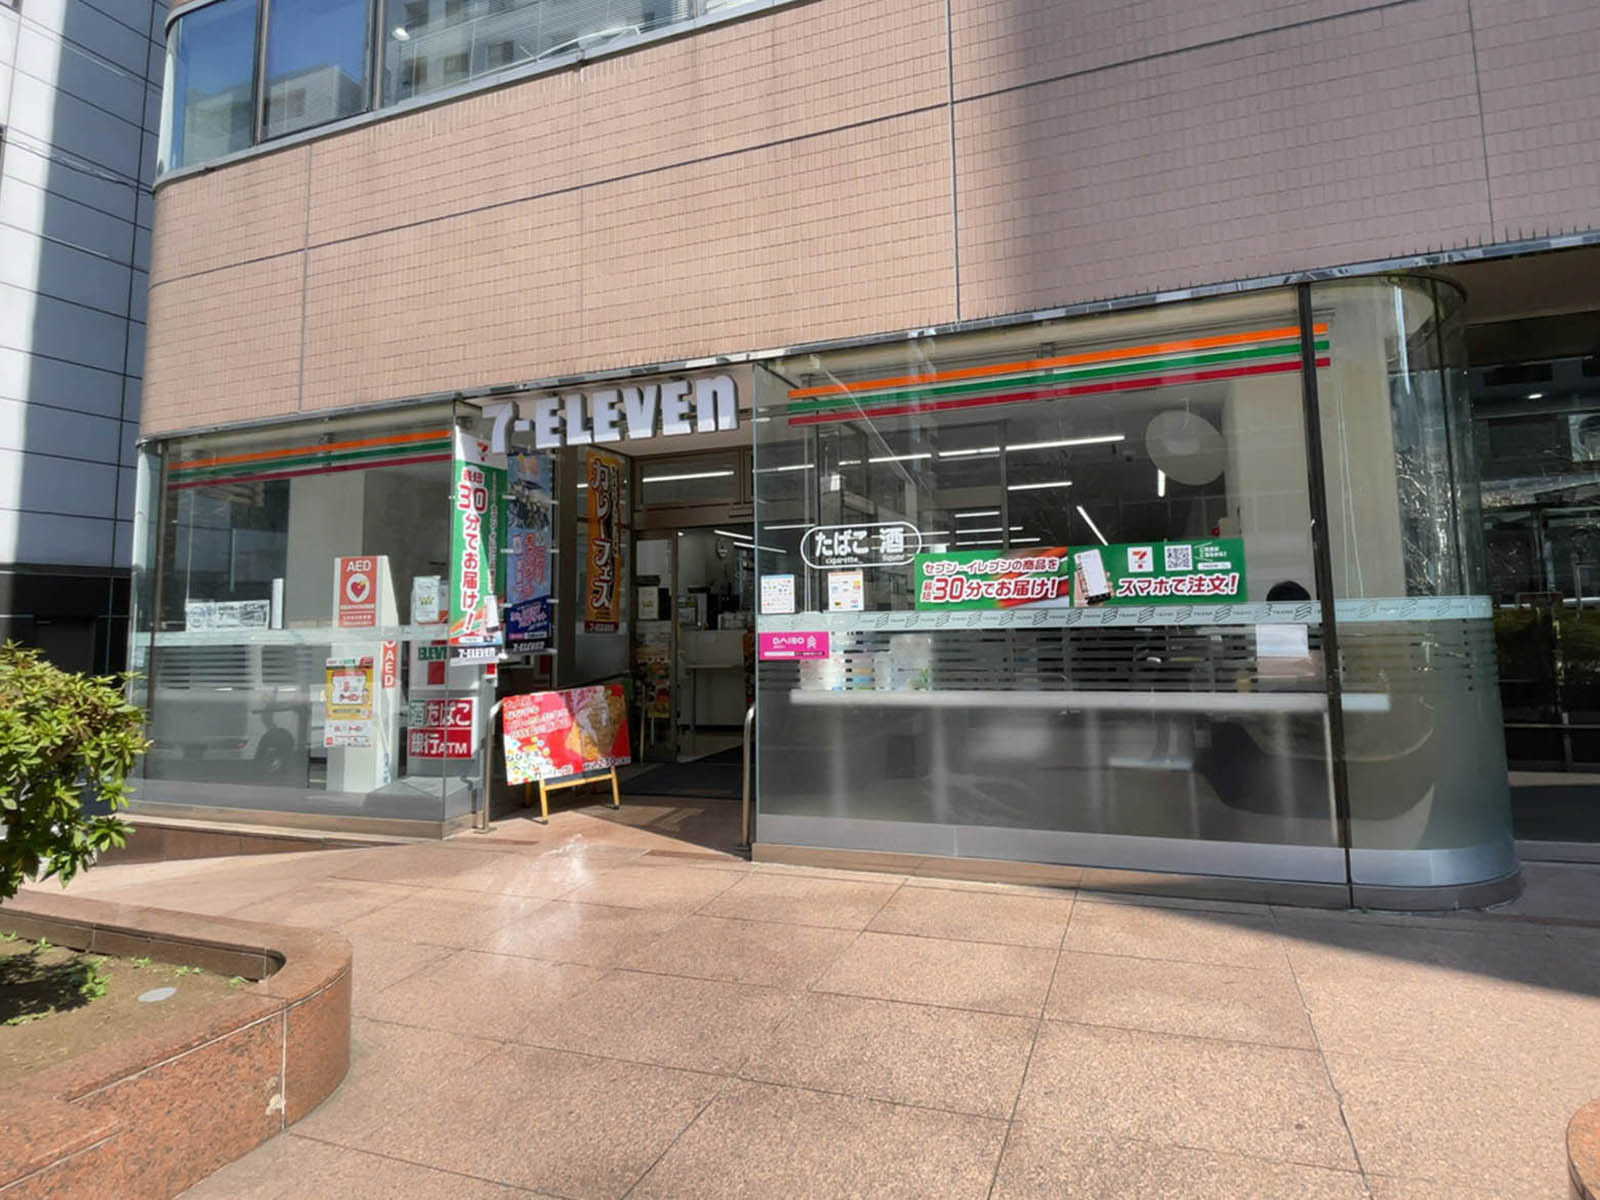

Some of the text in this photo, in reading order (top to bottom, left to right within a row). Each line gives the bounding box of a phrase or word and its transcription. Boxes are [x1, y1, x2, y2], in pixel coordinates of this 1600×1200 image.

[815, 528, 905, 557] たばこ 酒
[346, 559, 372, 571] AED
[1117, 574, 1239, 596] スマホで注文!
[772, 636, 805, 645] DAISO
[383, 648, 396, 687] AED
